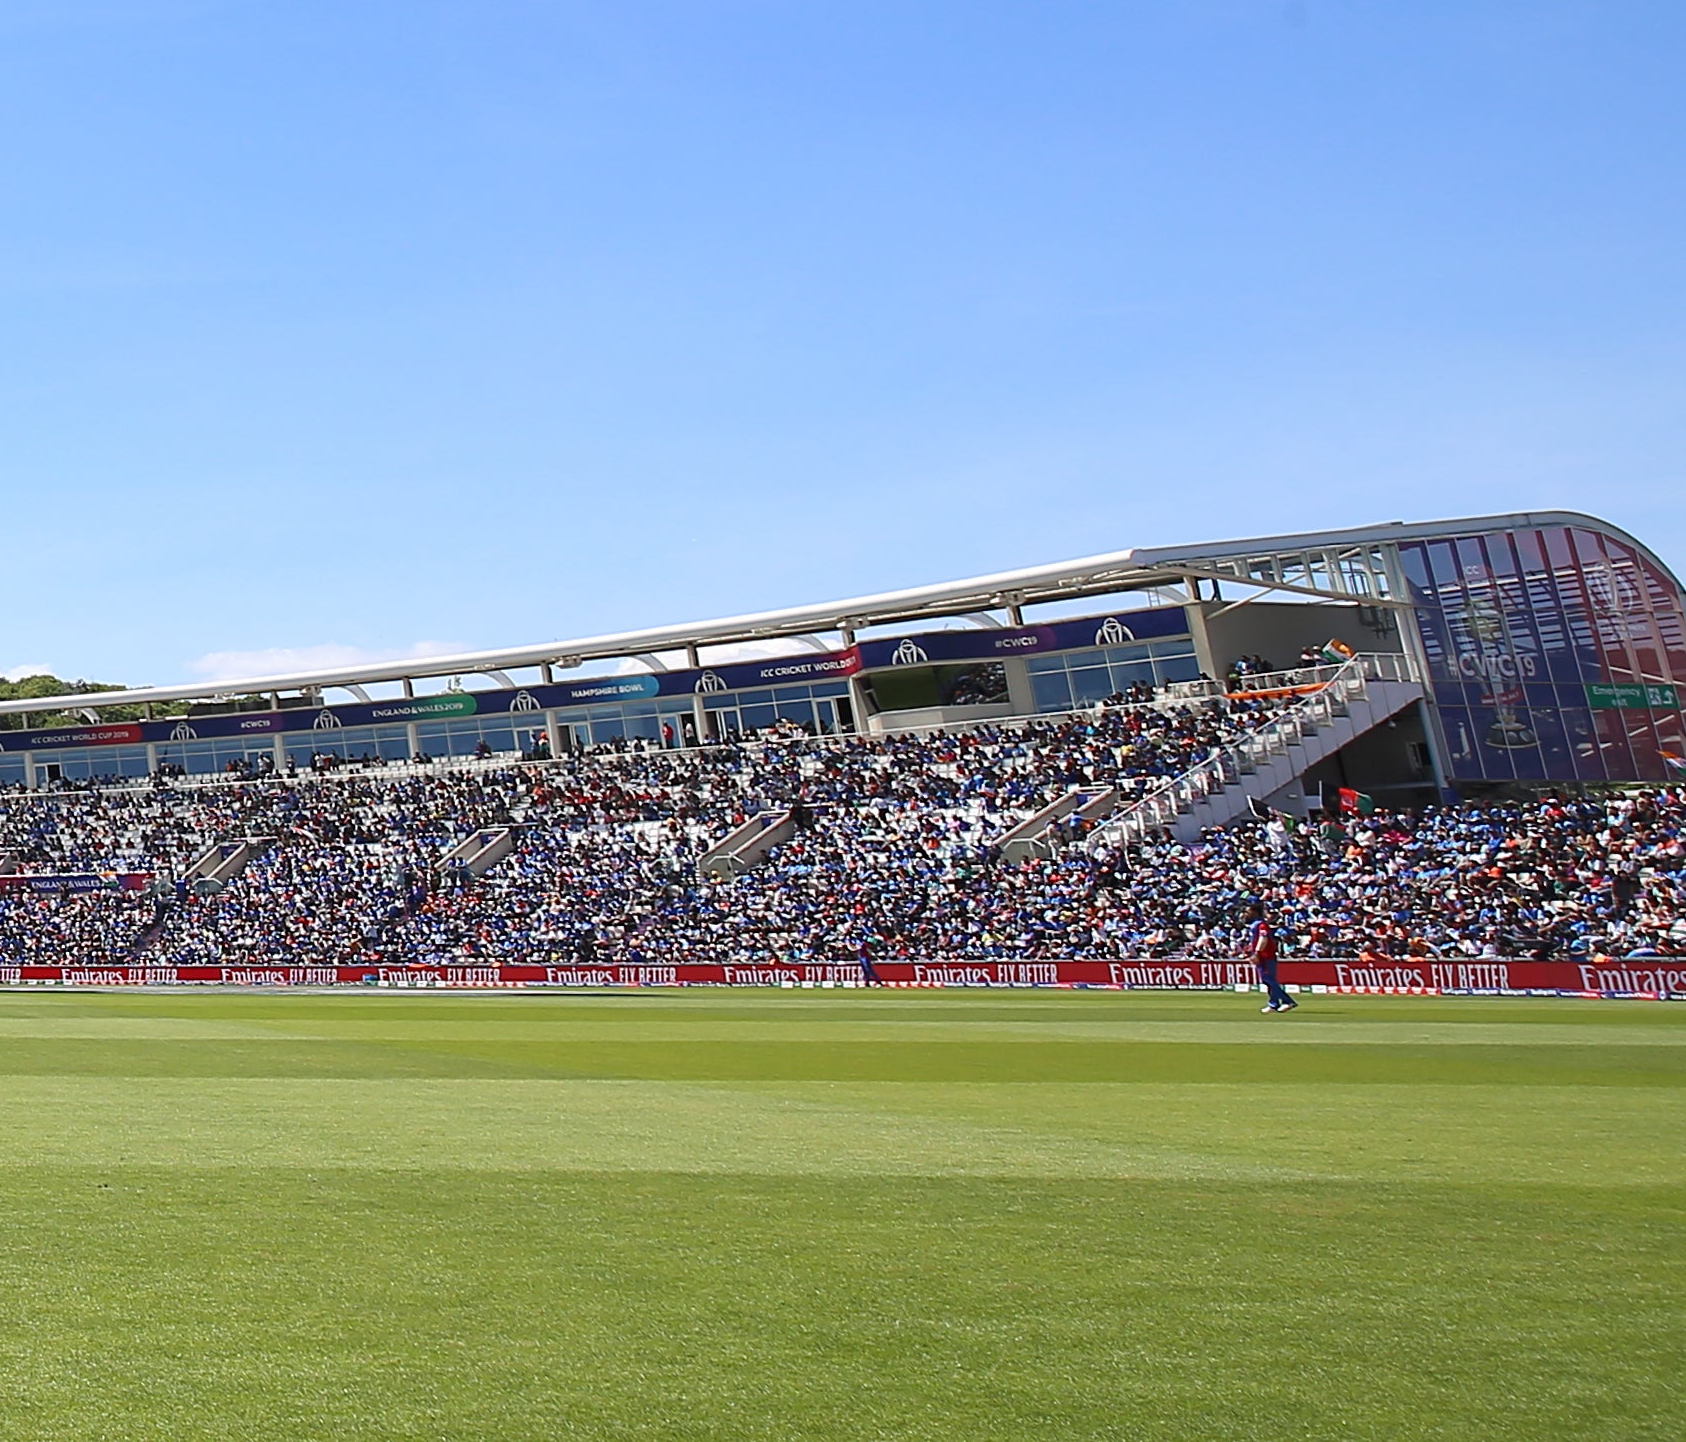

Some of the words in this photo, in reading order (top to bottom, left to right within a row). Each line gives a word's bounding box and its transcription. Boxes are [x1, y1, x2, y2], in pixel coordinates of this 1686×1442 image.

[995, 636, 1037, 648] #CWC19
[760, 668, 773, 677] ICC
[774, 664, 811, 676] CRICKET
[571, 686, 617, 698] HAMPSHIRE
[619, 683, 644, 694] BOWL
[1592, 686, 1640, 697] Emergency
[373, 706, 410, 718] ENGLAND
[418, 704, 445, 714] WALES
[445, 702, 464, 711] 2019
[43, 734, 70, 743] CRICKET
[72, 733, 96, 741] WORLD
[98, 732, 112, 740] CUP
[61, 967, 122, 980] Emirates
[144, 967, 178, 980] BETTER
[222, 967, 284, 981] Emirates
[305, 967, 338, 981] BETTER
[379, 967, 441, 982] Emirates
[465, 967, 500, 982] BETTER
[546, 966, 612, 982] Emirates
[639, 966, 676, 982] BETTER
[723, 966, 798, 982] Emirates
[827, 966, 864, 982] BETTER
[914, 965, 990, 983] Emirates
[1019, 965, 1058, 983] BETTER
[1109, 964, 1192, 985] Emirates
[1334, 963, 1425, 988] Emirates
[1457, 963, 1509, 988] BETTER
